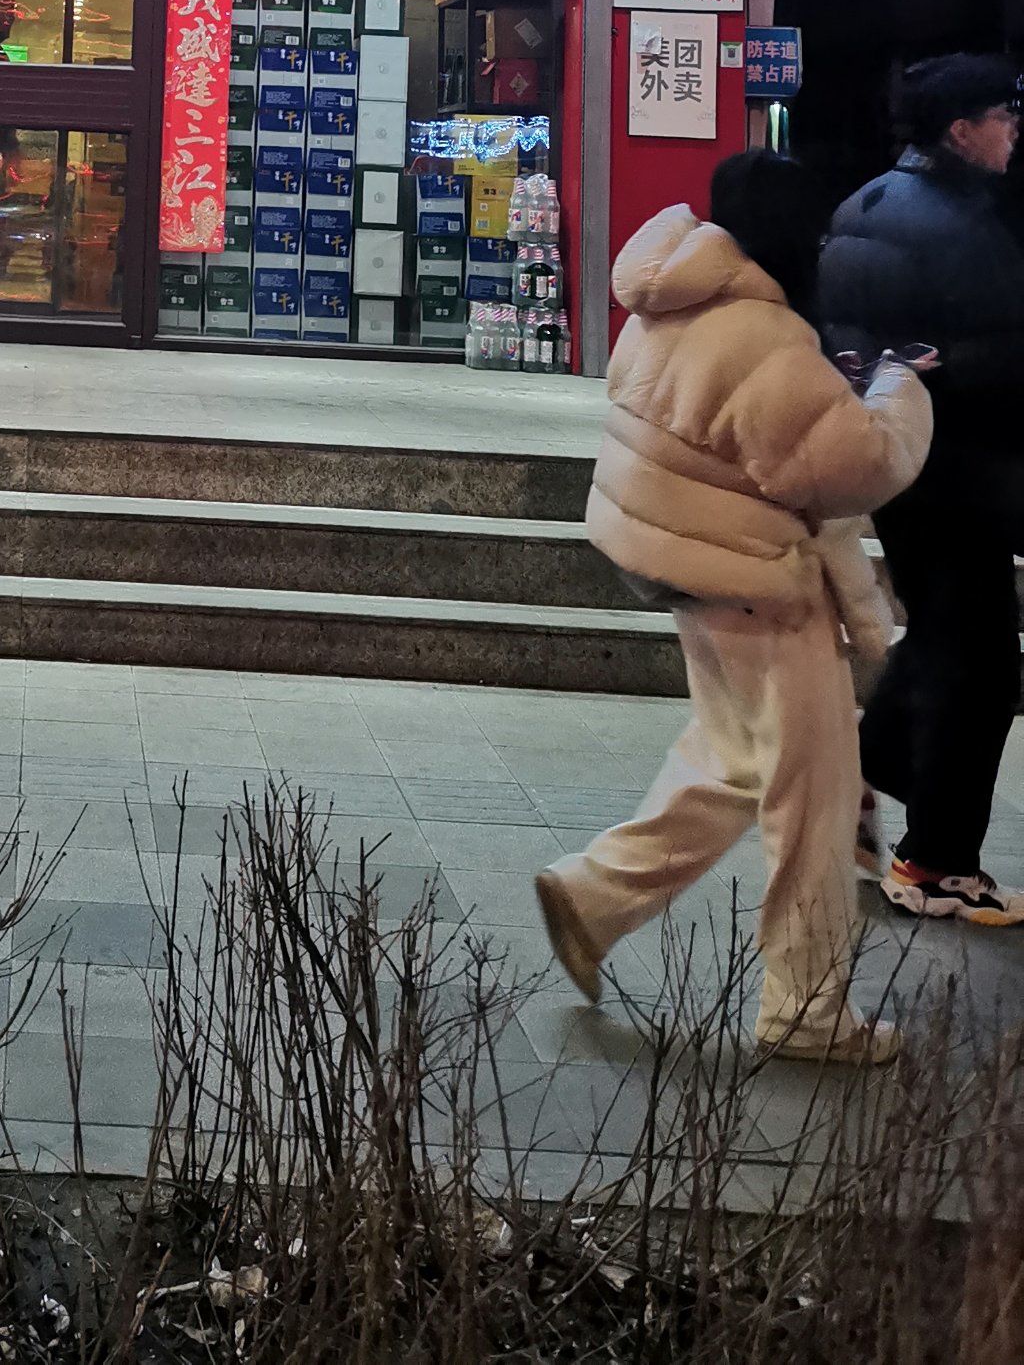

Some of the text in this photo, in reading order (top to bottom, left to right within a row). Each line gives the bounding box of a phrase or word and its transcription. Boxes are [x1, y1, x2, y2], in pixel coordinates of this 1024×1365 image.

[747, 40, 798, 60] 防车道
[747, 64, 796, 83] 禁占用
[640, 69, 703, 103] 外卖
